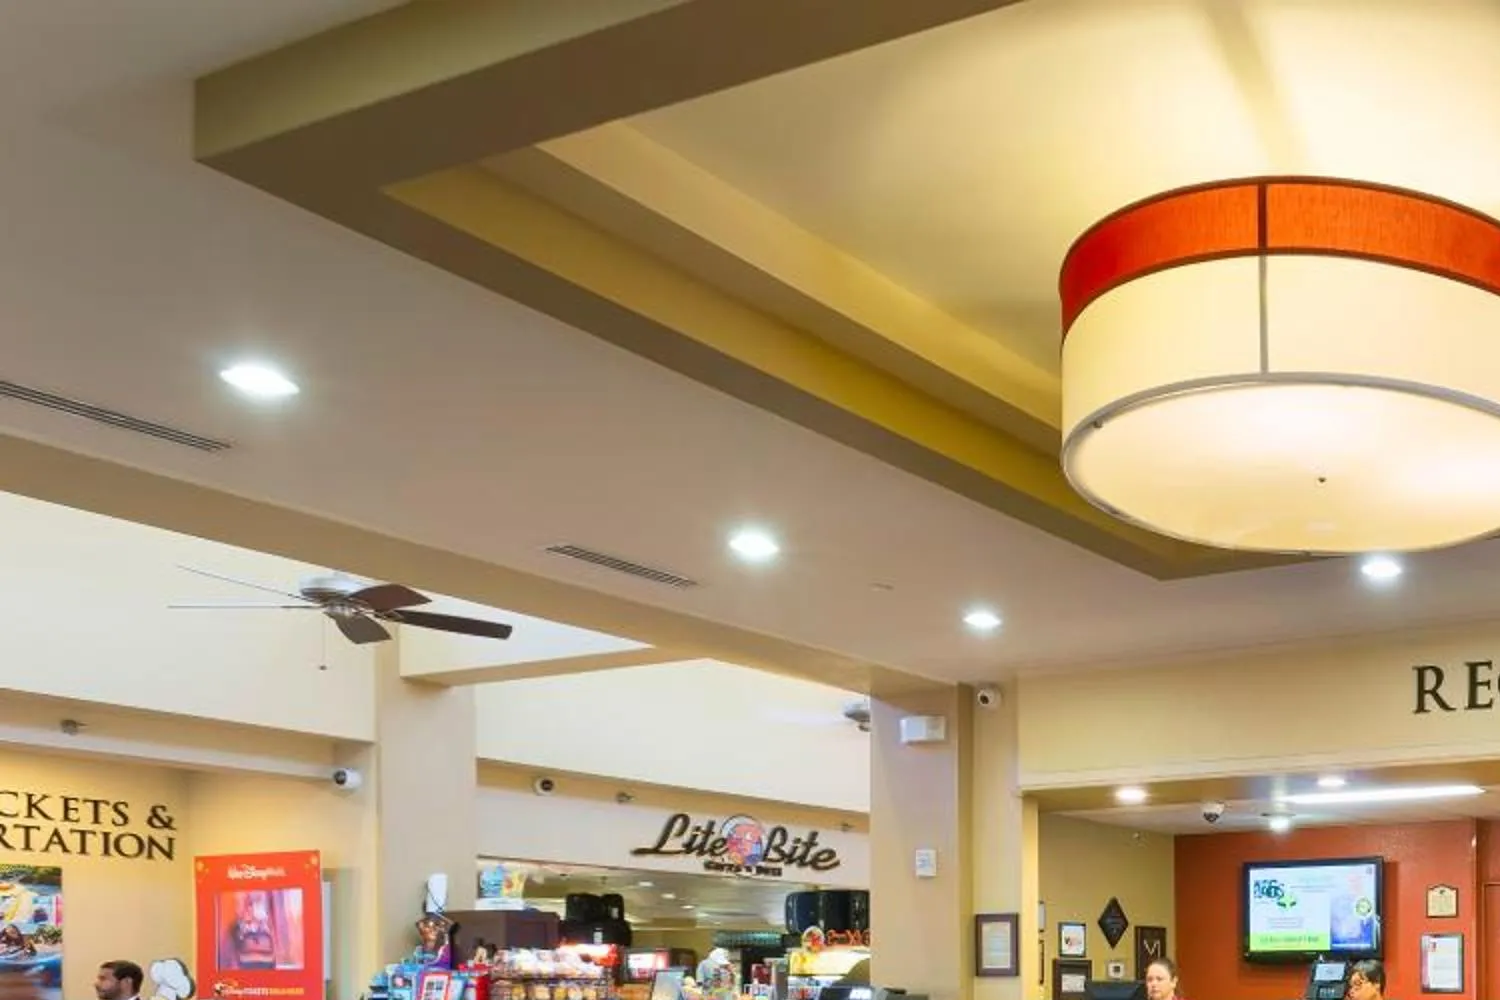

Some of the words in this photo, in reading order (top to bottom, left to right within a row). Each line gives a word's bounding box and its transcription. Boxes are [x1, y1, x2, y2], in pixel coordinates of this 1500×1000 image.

[147, 805, 177, 831] &
[631, 813, 728, 857] Lite
[762, 826, 840, 870] Bite
